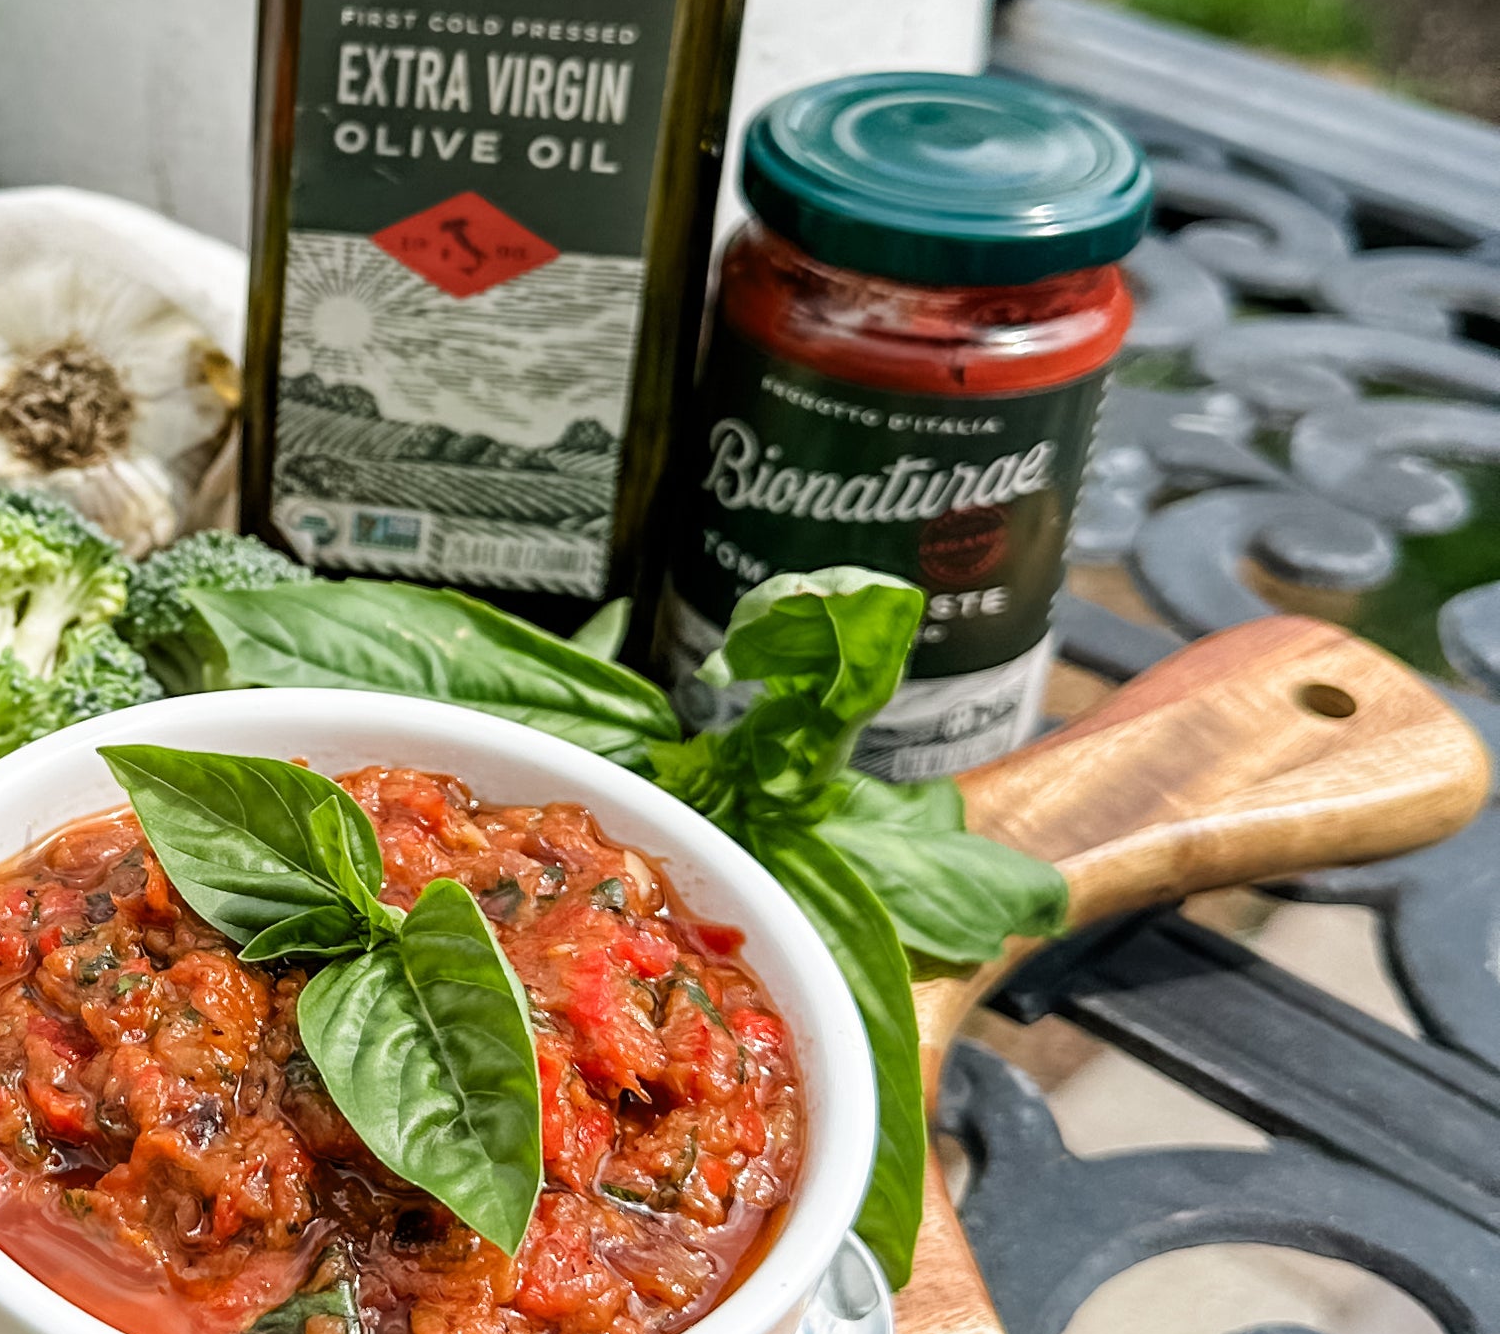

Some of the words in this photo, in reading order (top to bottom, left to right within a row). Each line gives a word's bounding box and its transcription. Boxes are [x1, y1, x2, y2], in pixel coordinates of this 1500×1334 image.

[341, 8, 416, 30] FIRST
[428, 13, 500, 36] COLD
[511, 19, 639, 45] PRESSED
[337, 44, 470, 113] EXTRA
[487, 51, 633, 124] VIRGIN
[334, 121, 500, 164] OLIVE
[528, 134, 619, 174] OIL
[702, 418, 1058, 522] Bionaturae
